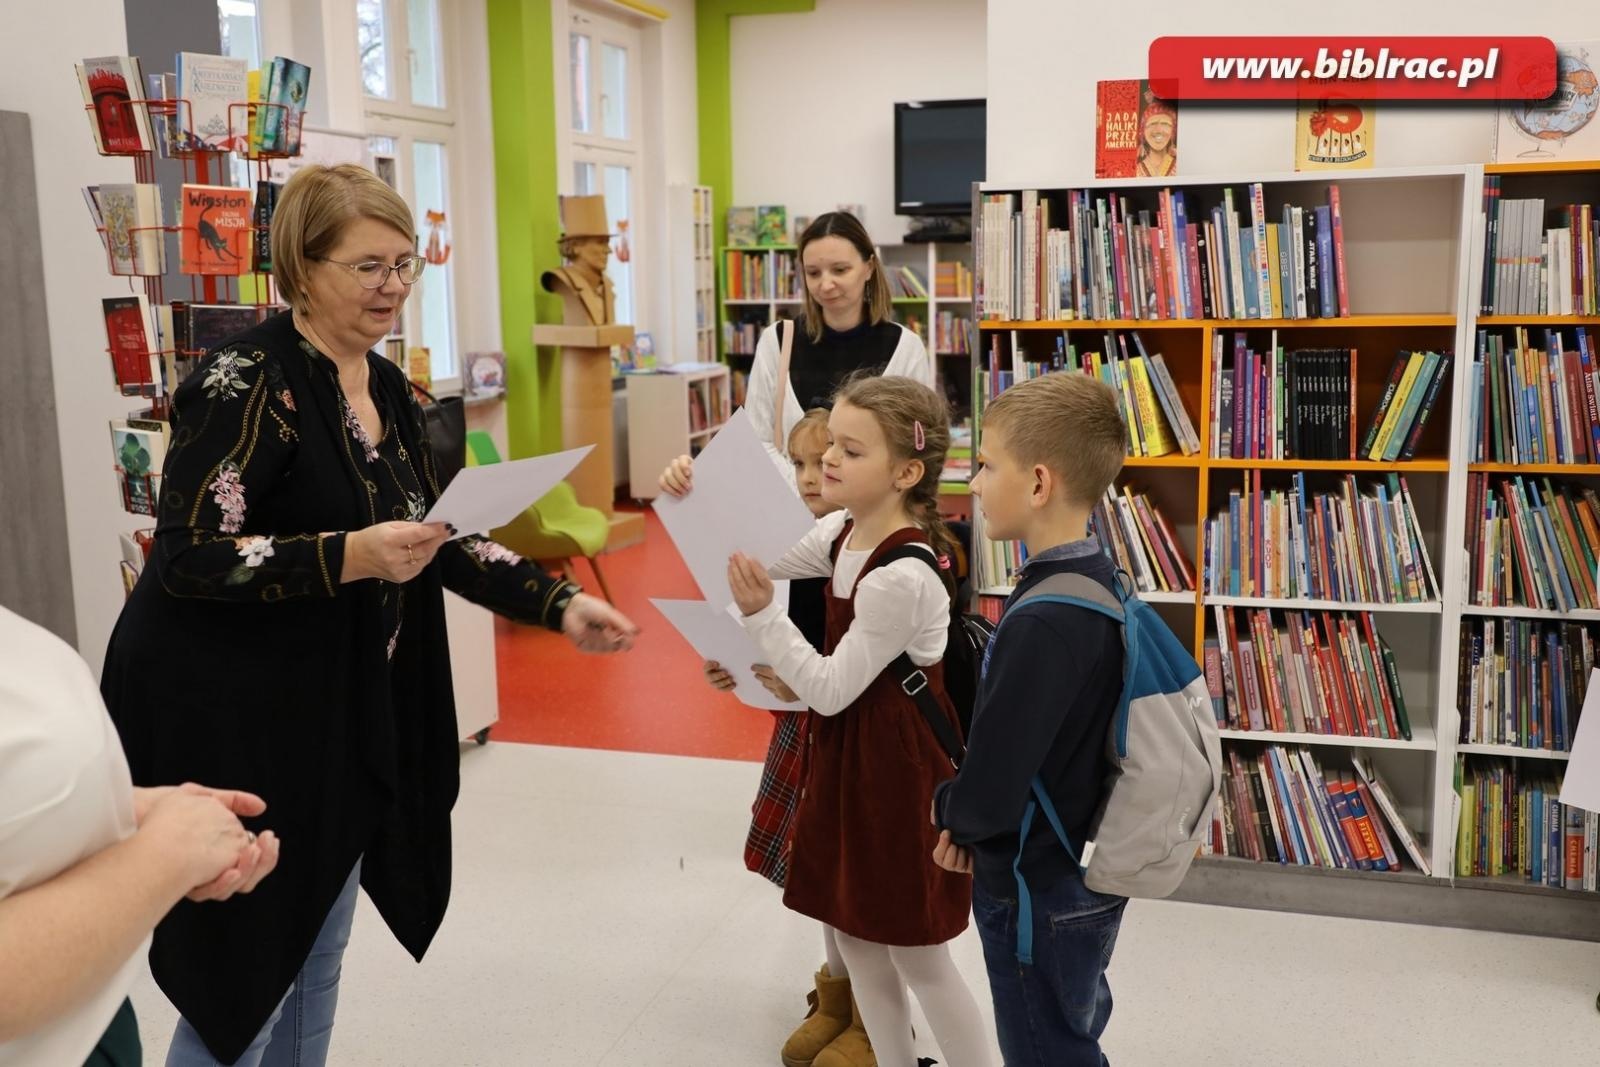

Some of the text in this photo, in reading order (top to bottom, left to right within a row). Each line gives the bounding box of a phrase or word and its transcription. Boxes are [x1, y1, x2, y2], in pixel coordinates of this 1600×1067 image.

[1104, 140, 1138, 149] AMERYKI
[1105, 131, 1138, 141] PRZEZ
[188, 191, 247, 208] Winston
[215, 217, 246, 228] MISJA
[1584, 372, 1593, 392] Atlas
[1551, 804, 1559, 833] CHEMIA
[1359, 822, 1375, 856] FIZYKA
